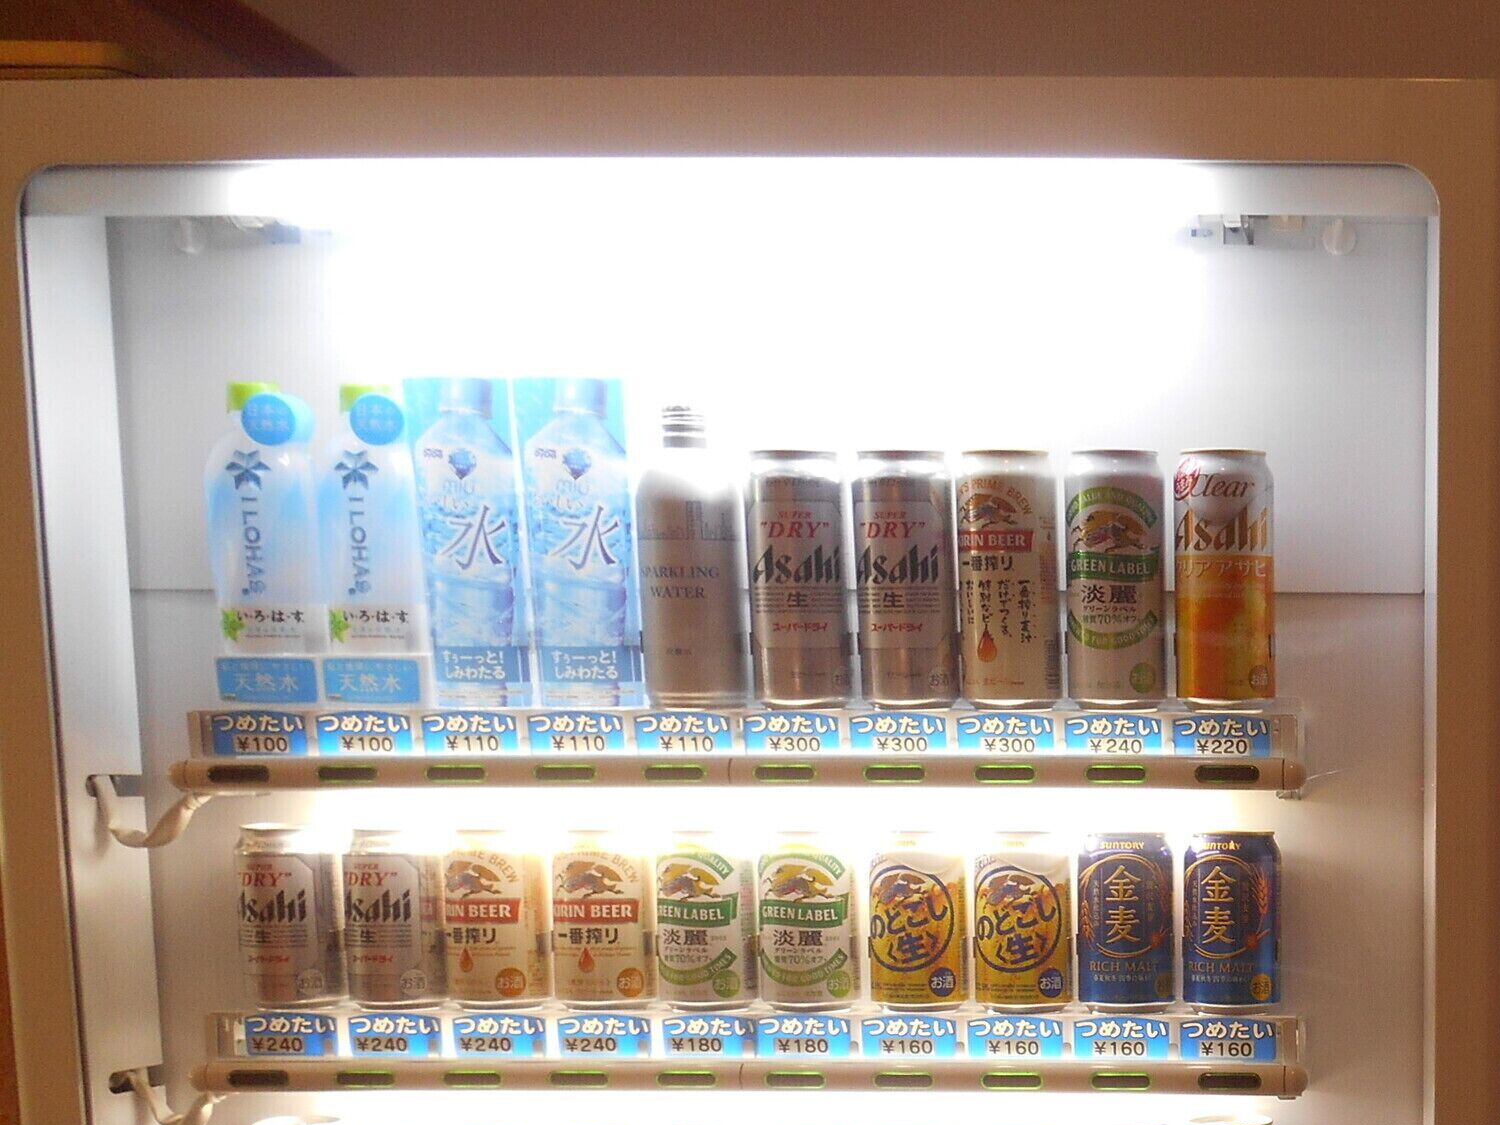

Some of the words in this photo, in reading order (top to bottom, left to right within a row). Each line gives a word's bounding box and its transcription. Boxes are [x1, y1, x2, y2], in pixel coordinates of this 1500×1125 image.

[1190, 473, 1255, 498] Clear
[441, 505, 506, 570] 水
[989, 535, 1025, 546] BEER
[752, 544, 840, 584] Asahi
[962, 556, 1013, 571] 一番搾り
[1071, 559, 1105, 573] GREEN
[1109, 560, 1149, 575] LABEL
[650, 587, 706, 599] WATER
[787, 591, 808, 607] 生
[1081, 585, 1137, 604] 淡麗
[446, 666, 506, 680] しみわたる
[340, 673, 401, 692] 天然水
[745, 716, 839, 735] つめたい
[1175, 718, 1268, 738] つめたい
[237, 736, 288, 752] ¥100
[446, 735, 498, 752] ¥110
[661, 735, 713, 753] ¥110
[877, 736, 929, 753] ¥300
[1090, 737, 1143, 754] ¥240
[1197, 738, 1248, 755] ¥220
[591, 904, 632, 919] BEER
[1104, 866, 1141, 944] 金麦
[1201, 866, 1236, 944] 金麦
[762, 906, 796, 919] GREEN
[799, 907, 839, 921] LABEL
[558, 929, 619, 945] 一番搾り
[774, 930, 822, 947] 淡麗
[1089, 961, 1123, 973] RICH
[931, 976, 954, 989] お酒
[350, 1017, 439, 1035] つめたい
[1183, 1021, 1274, 1040] つめたい
[252, 1037, 303, 1052] ¥240
[566, 1037, 617, 1052] ¥240
[672, 1038, 722, 1053] ¥180
[1094, 1042, 1145, 1056] ¥160
[1202, 1042, 1252, 1057] ¥160
